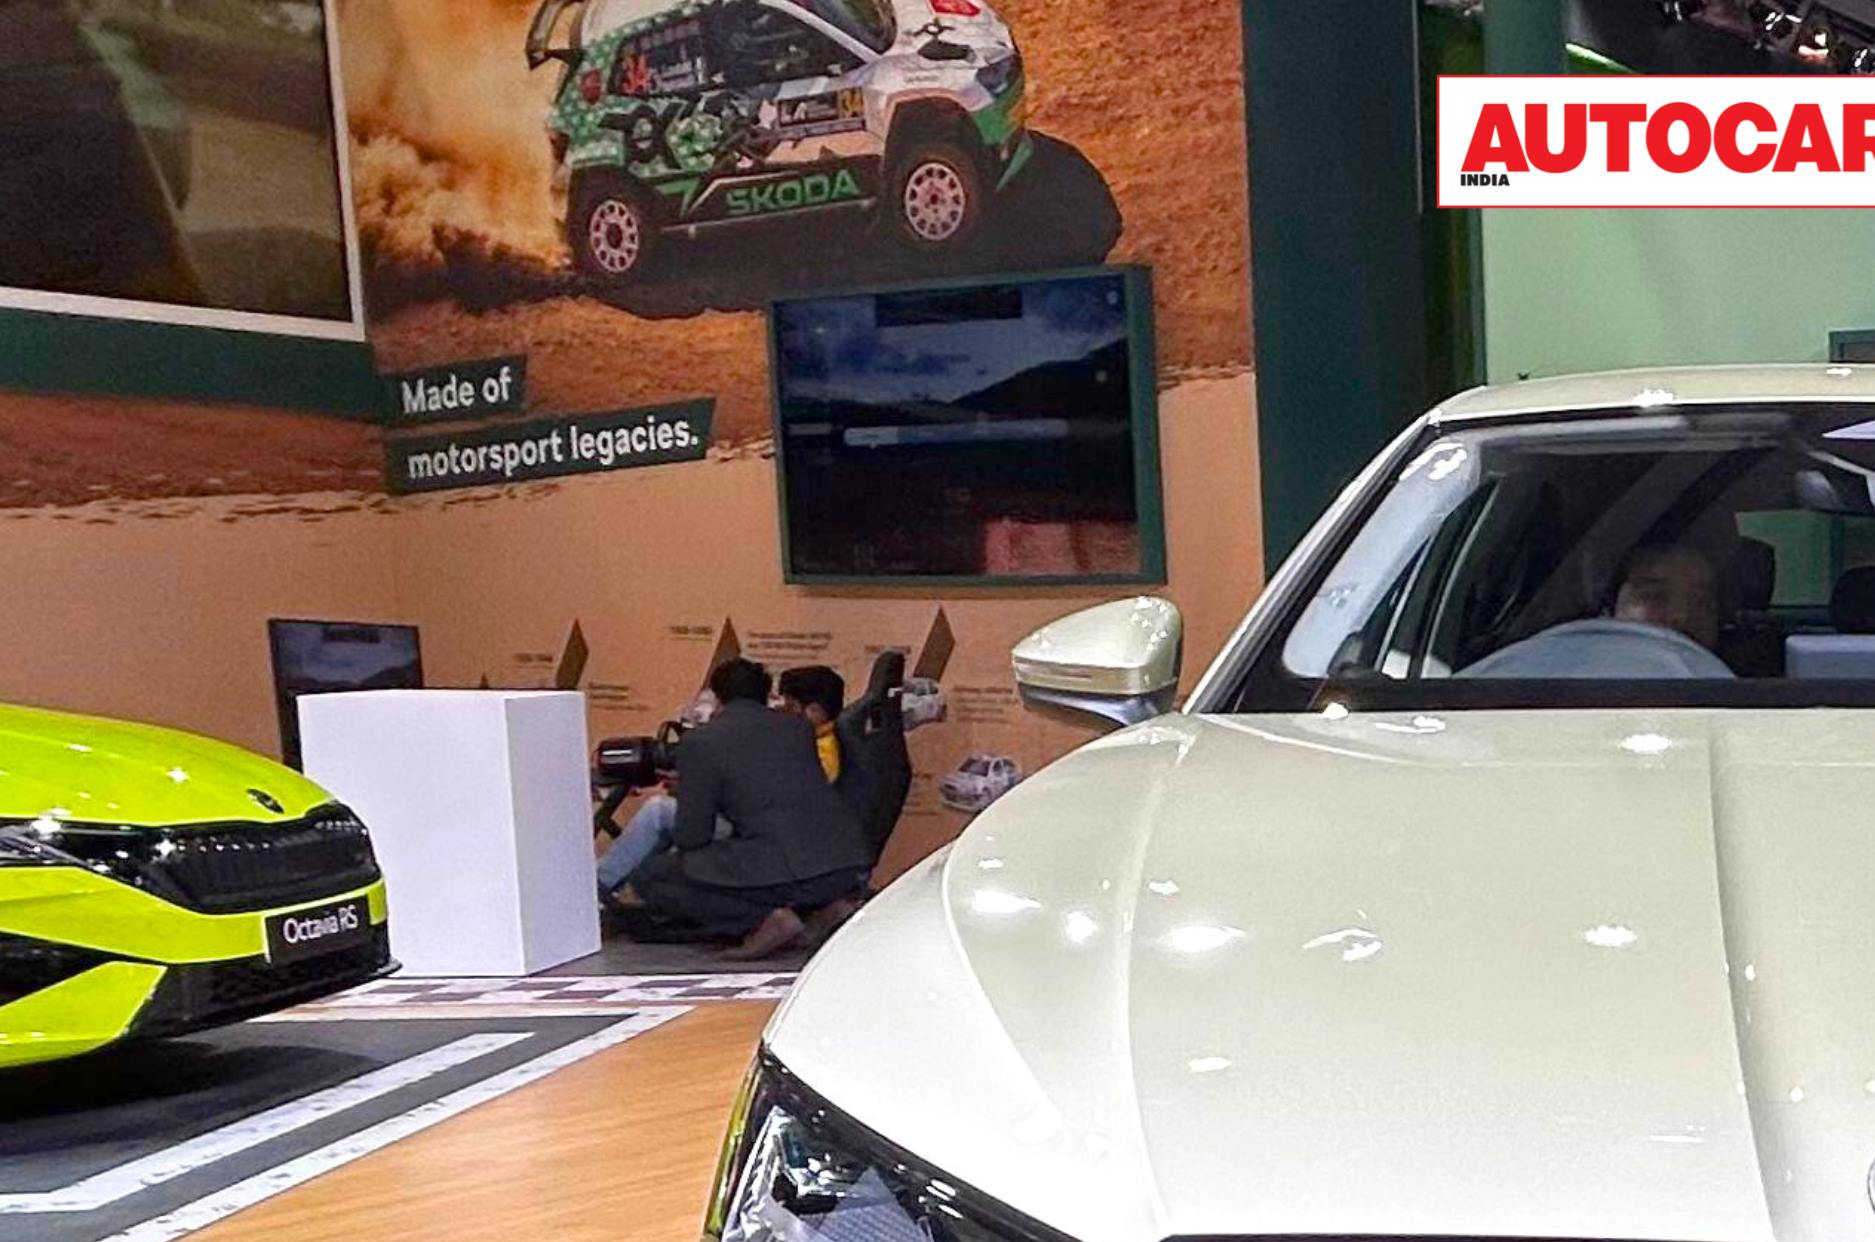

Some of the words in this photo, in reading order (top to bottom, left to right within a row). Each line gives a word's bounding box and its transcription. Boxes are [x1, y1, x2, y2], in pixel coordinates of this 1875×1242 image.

[401, 374, 475, 414] Made
[482, 366, 513, 400] of
[407, 429, 564, 480] motorsport
[569, 415, 699, 466] legacies.
